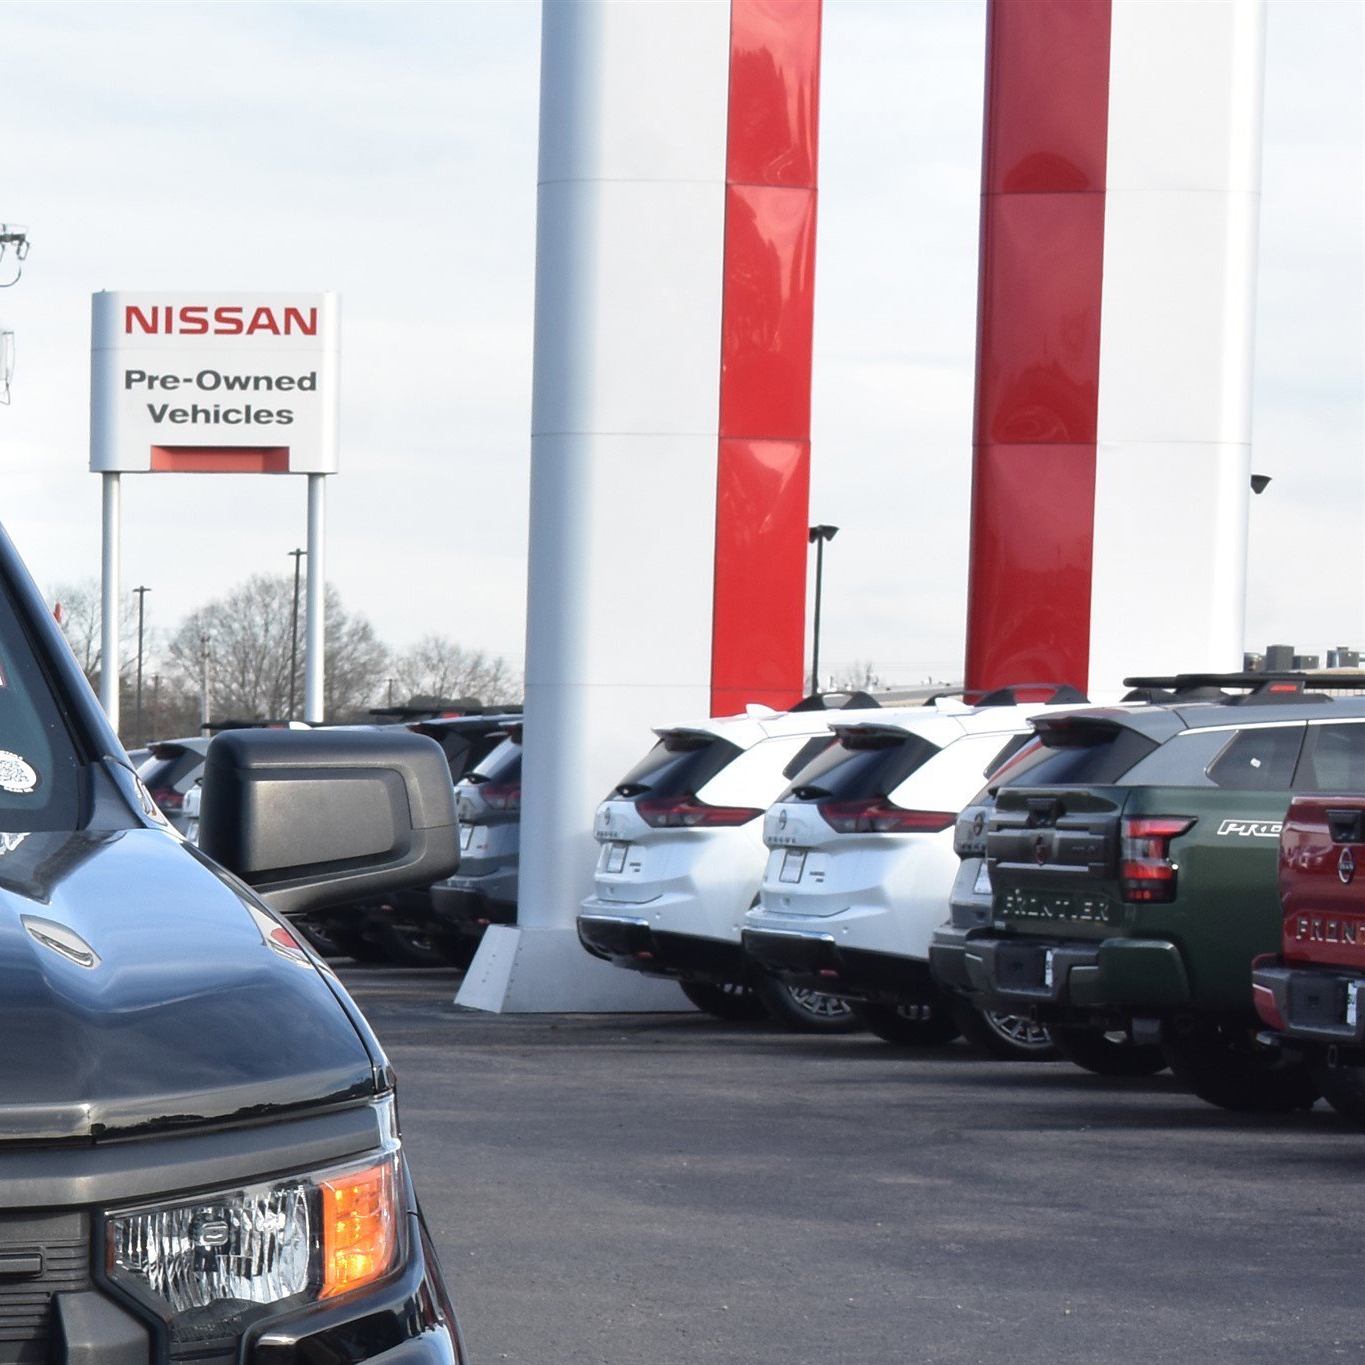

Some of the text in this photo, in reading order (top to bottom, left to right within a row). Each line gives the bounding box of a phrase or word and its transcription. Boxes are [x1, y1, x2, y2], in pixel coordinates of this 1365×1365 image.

[125, 305, 318, 336] NISSAN
[124, 369, 317, 391] Pre-Owned
[147, 404, 294, 425] Vehicles
